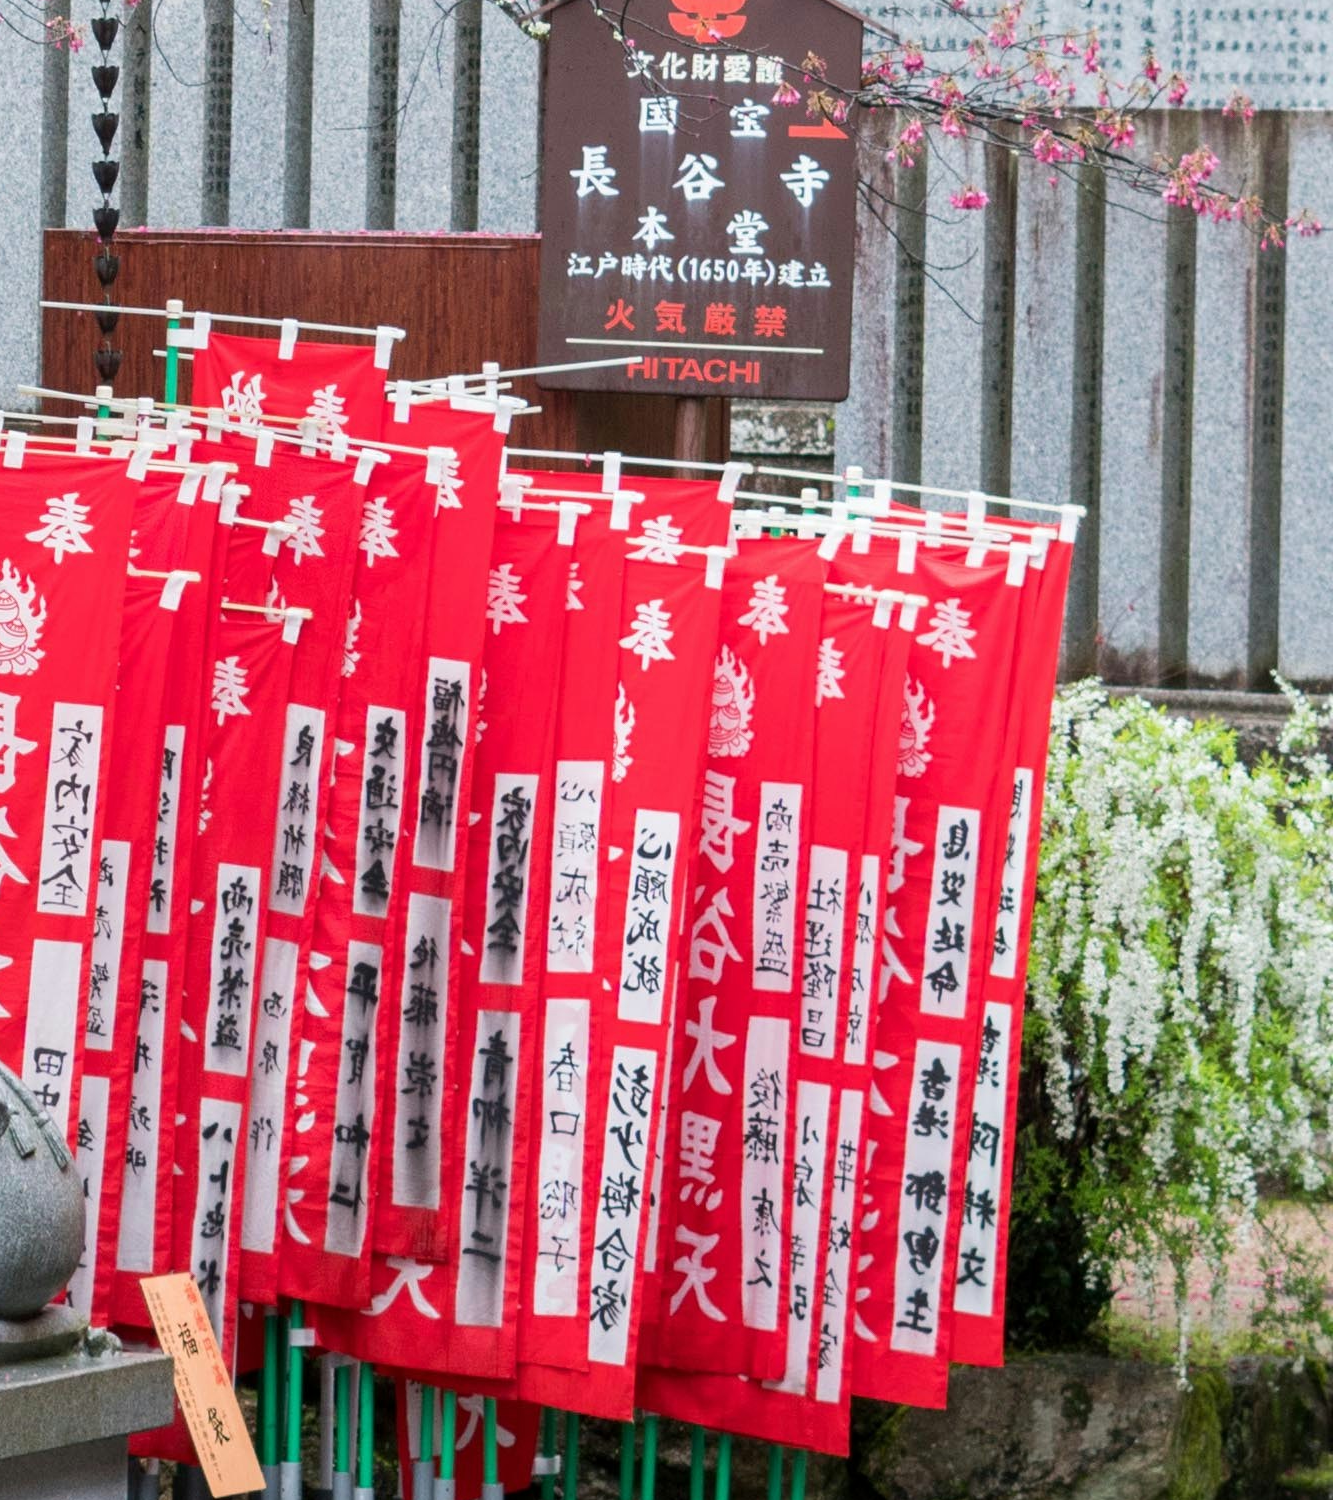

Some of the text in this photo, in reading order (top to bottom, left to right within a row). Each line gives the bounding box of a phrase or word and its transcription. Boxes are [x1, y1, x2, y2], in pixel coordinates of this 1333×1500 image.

[625, 51, 784, 87] 文化財愛護
[637, 96, 771, 138] 国宝
[568, 144, 832, 208] 長谷寺
[631, 206, 770, 255] 本堂
[603, 300, 788, 339] 火気厳禁
[626, 355, 761, 385] HITACHI
